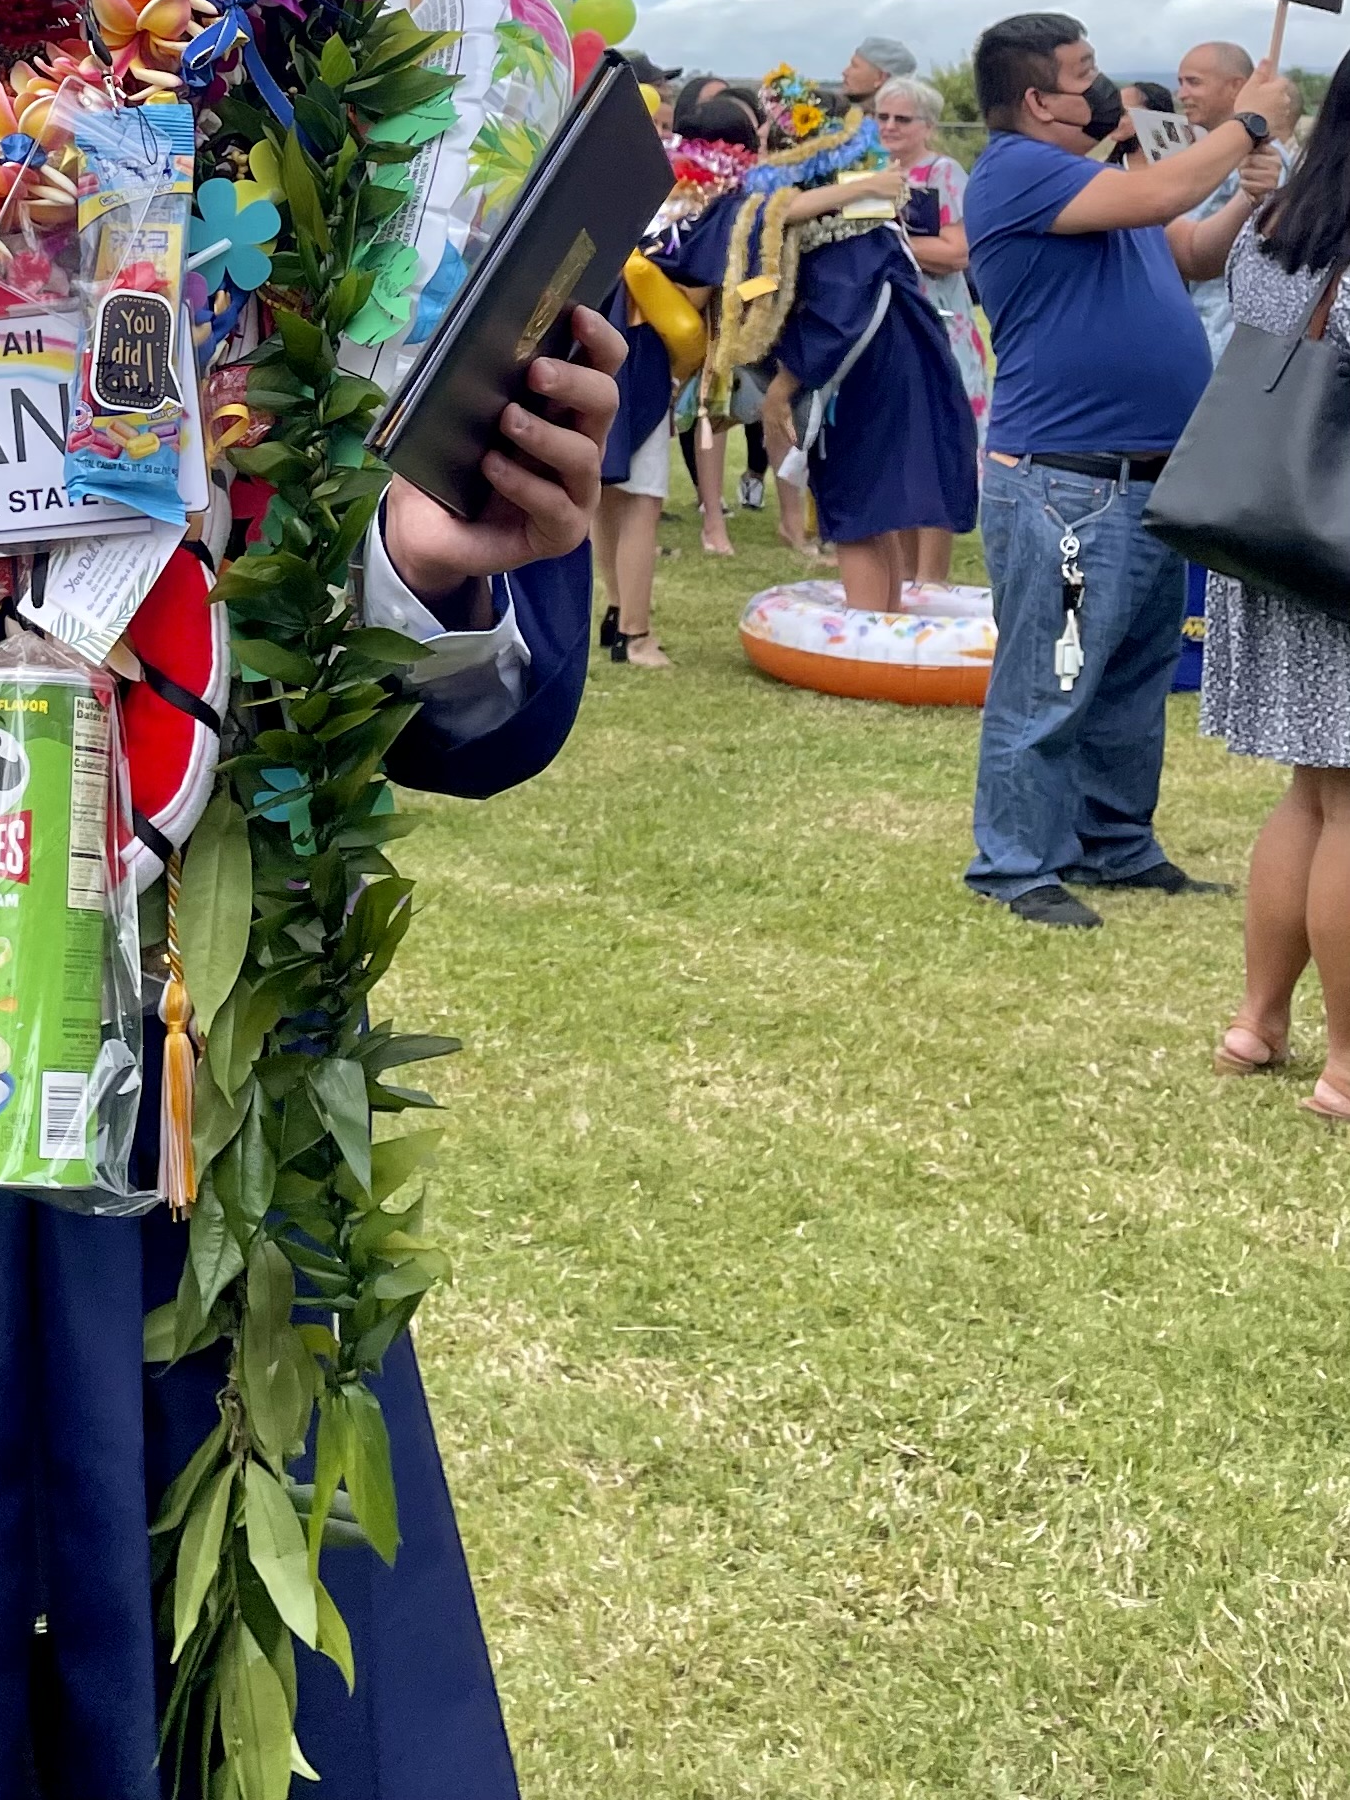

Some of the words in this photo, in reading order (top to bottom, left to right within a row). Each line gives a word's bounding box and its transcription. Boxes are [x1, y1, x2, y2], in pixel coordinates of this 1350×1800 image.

[120, 309, 155, 335] You
[111, 337, 141, 366] did
[63, 570, 86, 594] You
[78, 542, 100, 571] Did
